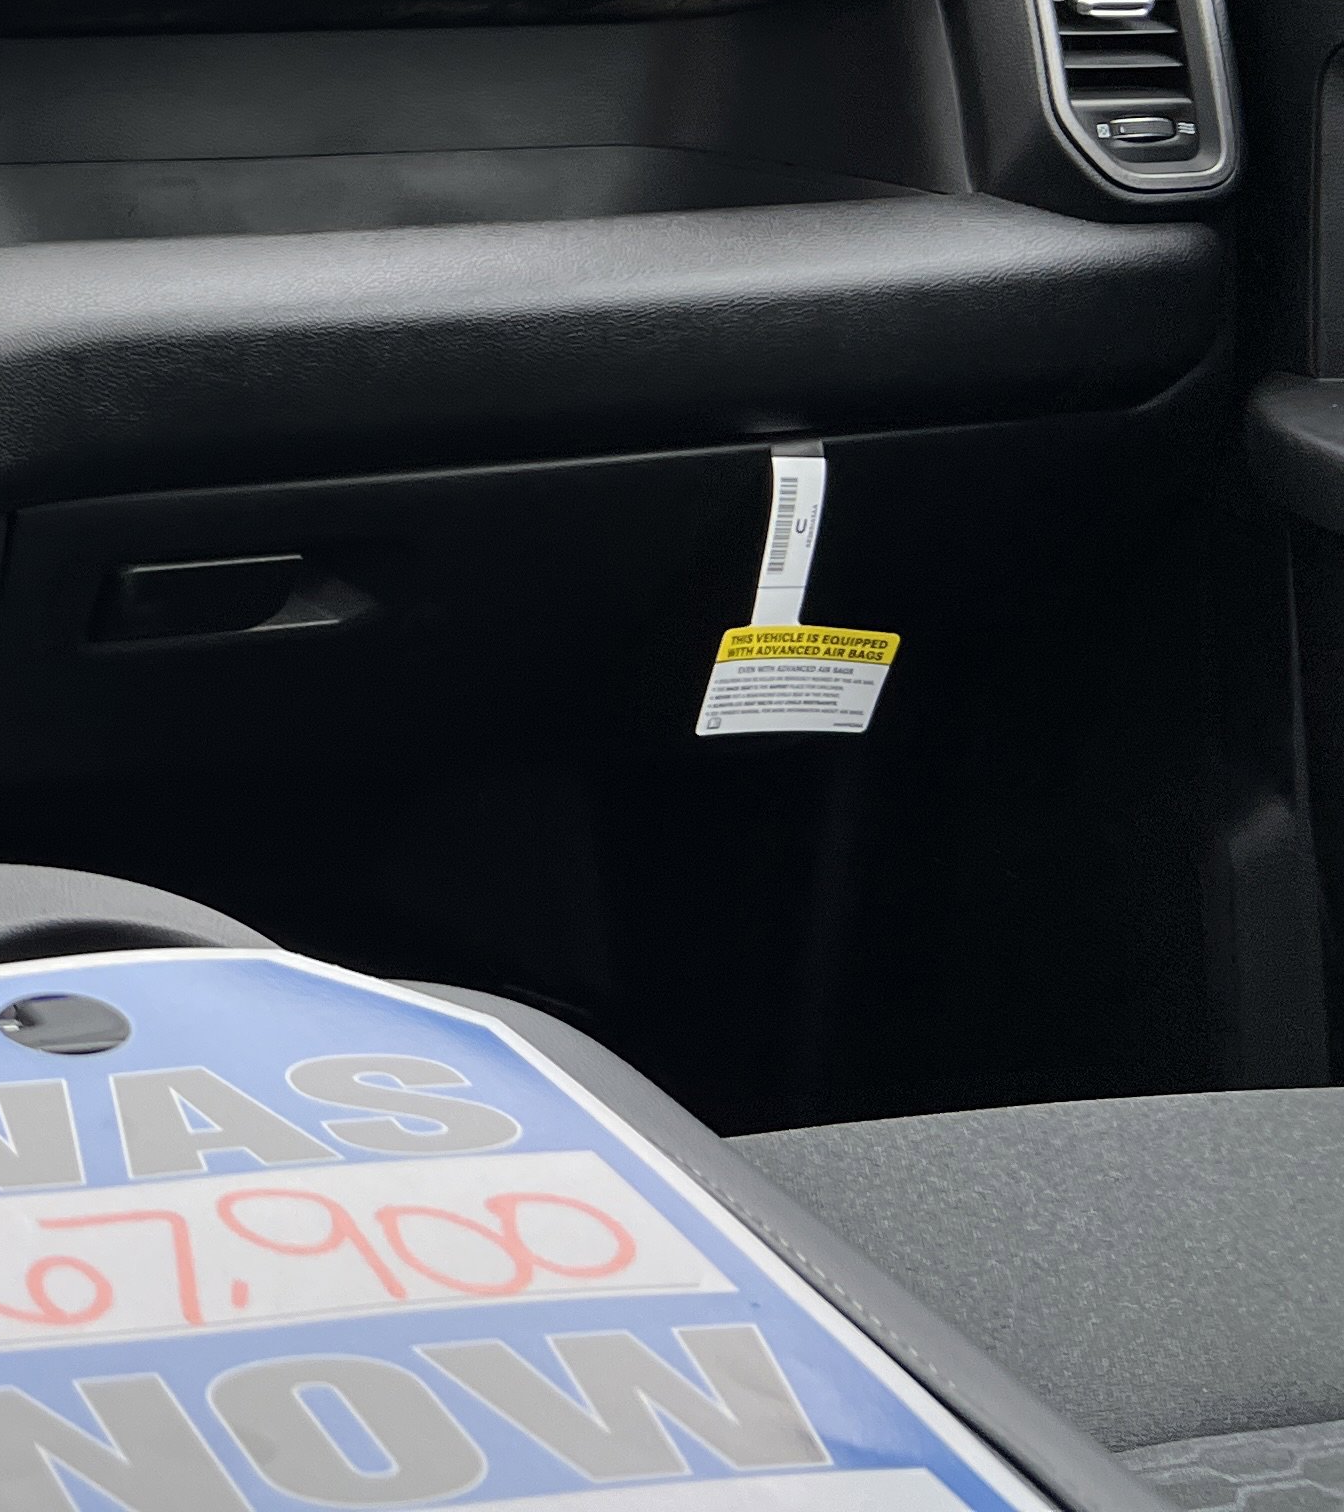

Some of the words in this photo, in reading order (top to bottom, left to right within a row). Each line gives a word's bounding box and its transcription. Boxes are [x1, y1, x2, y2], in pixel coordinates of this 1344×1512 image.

[730, 634, 754, 646] THIS
[756, 632, 802, 644] VEHICLE
[806, 632, 819, 643] IS
[822, 635, 889, 650] EQUIPPED
[727, 646, 754, 658] WITH
[755, 645, 820, 656] ADVANCED
[823, 646, 846, 658] AIR
[848, 647, 885, 662] BAGS
